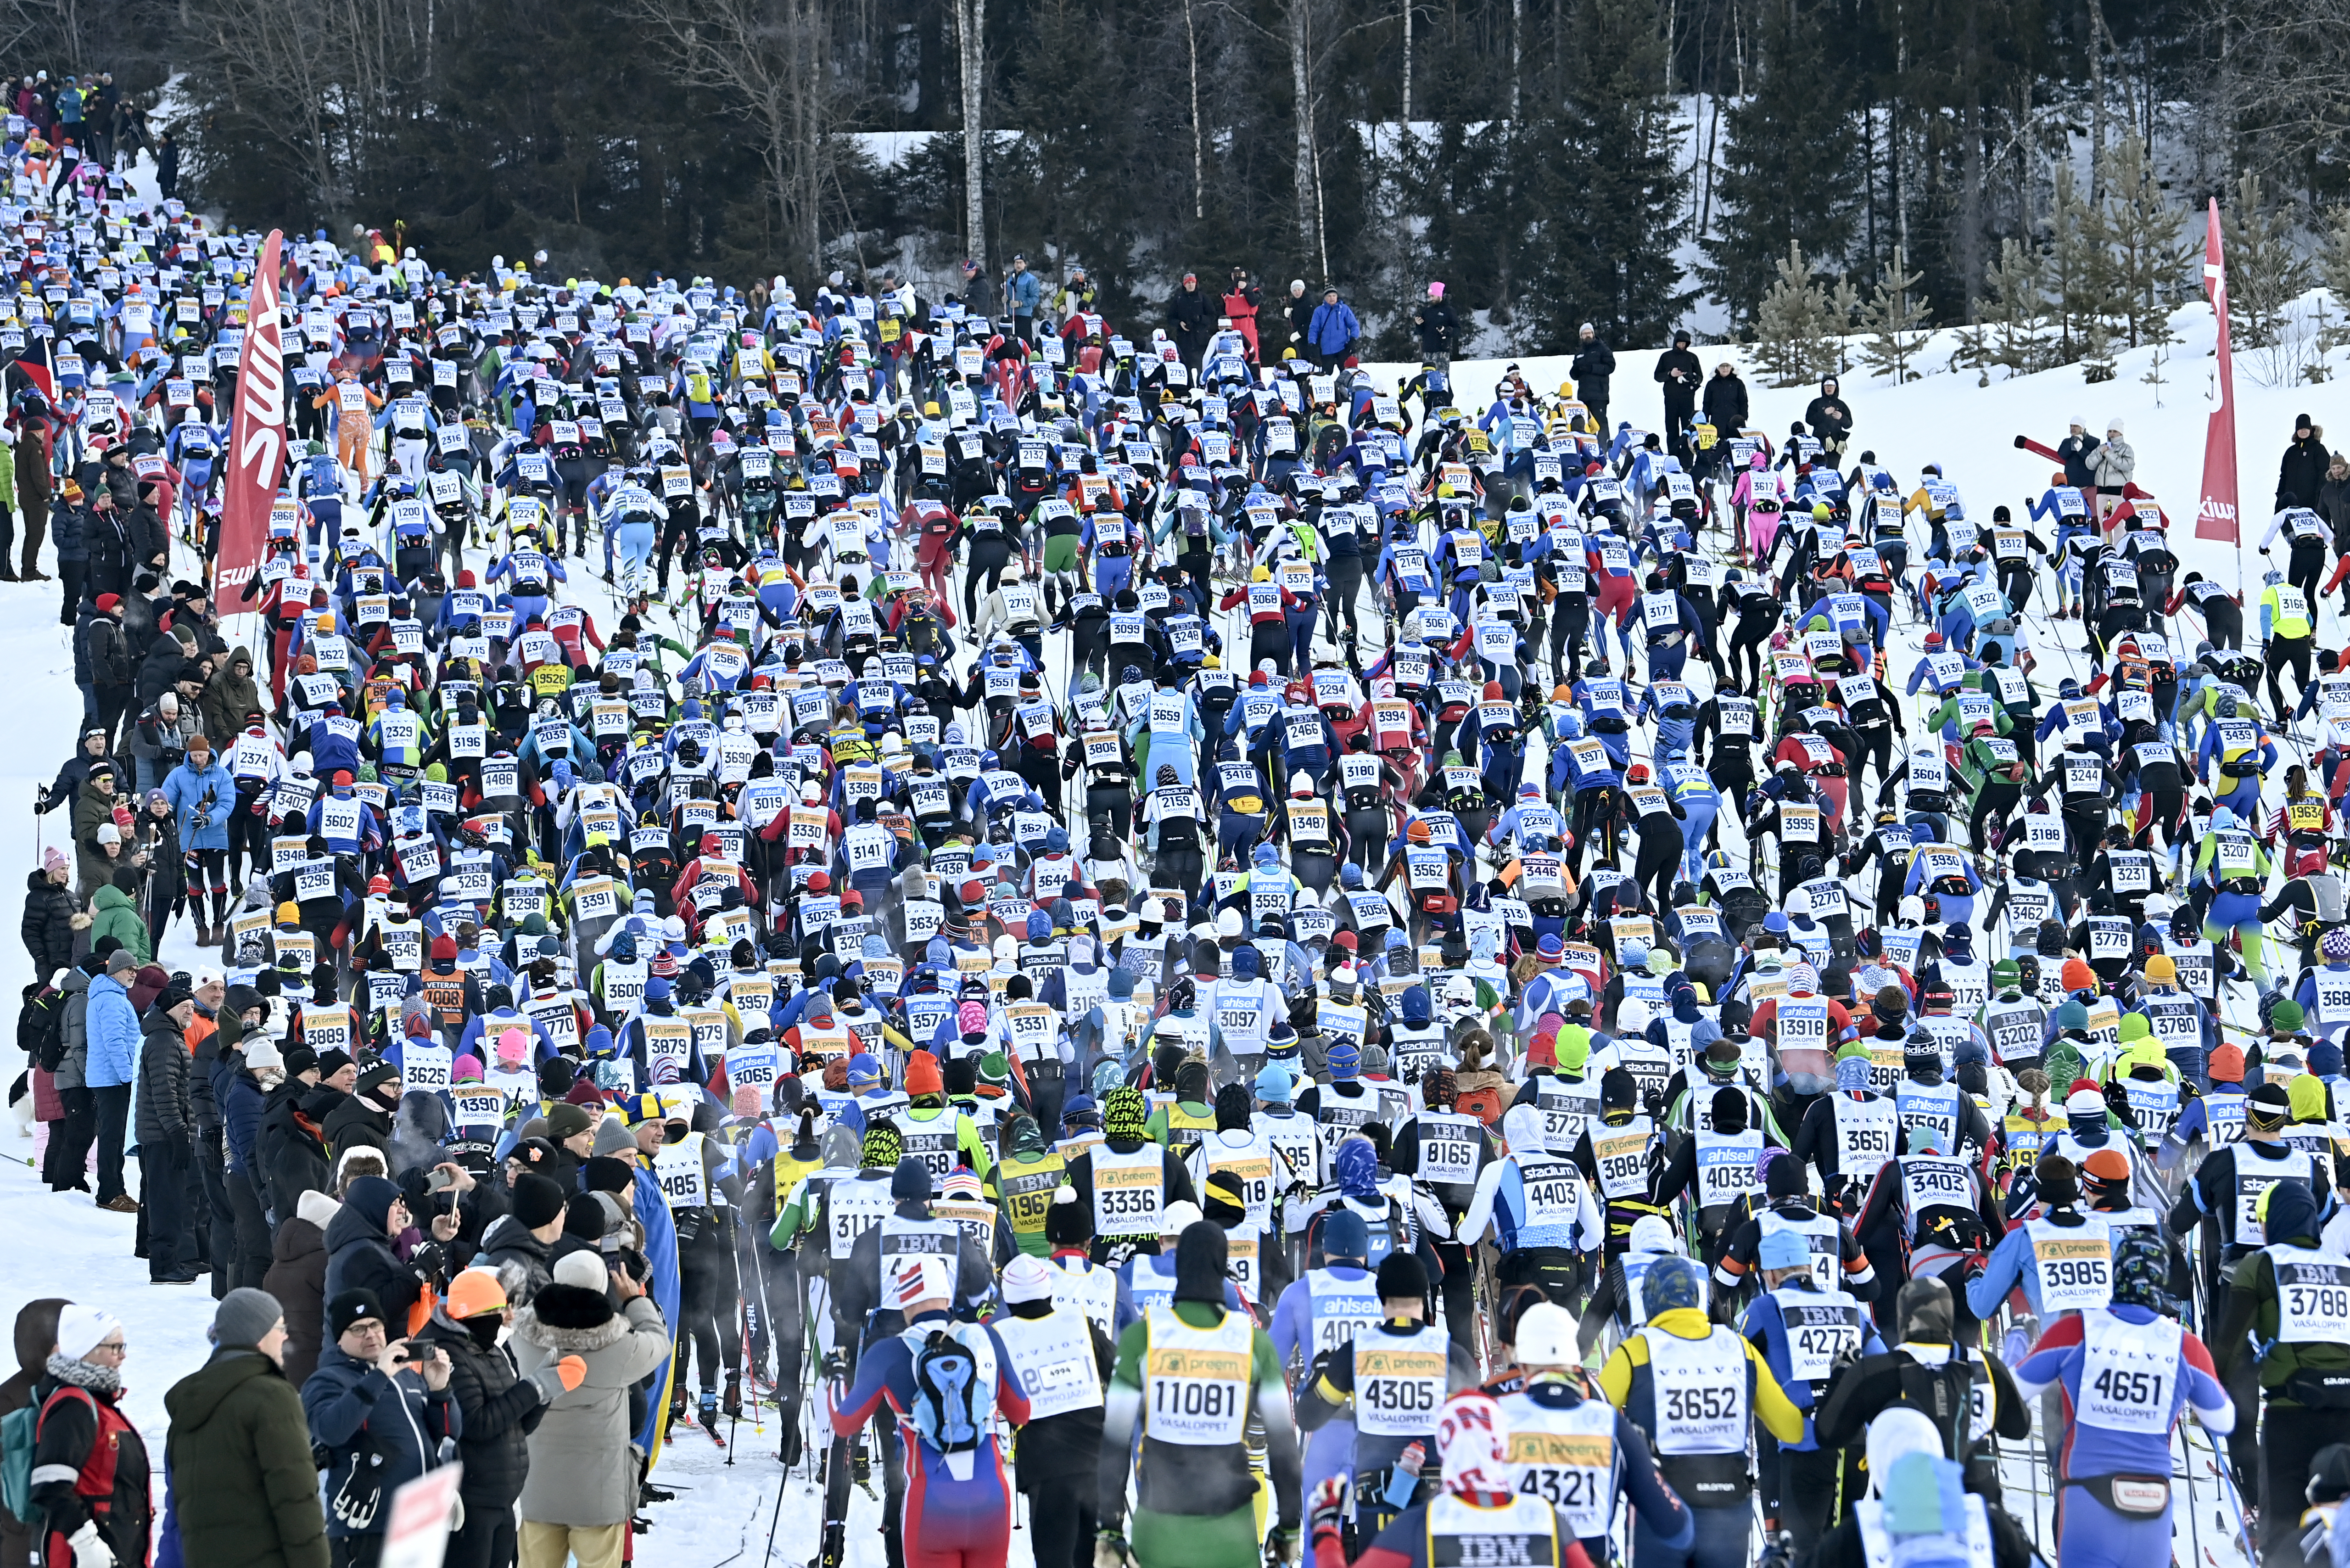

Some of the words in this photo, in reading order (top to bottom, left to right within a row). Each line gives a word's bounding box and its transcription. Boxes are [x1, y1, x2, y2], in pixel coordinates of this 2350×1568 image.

[629, 330, 647, 338] 3536
[436, 484, 457, 494] 3612
[667, 479, 688, 488] 2090
[1755, 483, 1774, 492] 3617
[2000, 539, 2023, 549] 3312
[1401, 558, 1422, 567] 2140
[218, 558, 256, 589] swi
[1009, 599, 1031, 609] 2713
[1253, 596, 1277, 605] 3068
[2283, 599, 2304, 610] 3166
[398, 634, 419, 644] 2111
[1810, 641, 1841, 650] 12935
[715, 654, 739, 666] 2586
[536, 674, 565, 686] 19526
[990, 678, 1015, 689] 3551
[309, 683, 334, 696] 3178
[747, 703, 775, 714] 3783
[597, 715, 625, 726] 3376
[1153, 710, 1181, 722] 3659
[1725, 714, 1750, 726] 2442
[1292, 724, 1318, 736] 2466
[454, 737, 481, 749] 3196
[1089, 743, 1117, 756] 3806
[241, 753, 268, 767] 2374
[949, 756, 977, 767] 2498
[486, 774, 514, 787] 4488
[1913, 770, 1942, 782] 3604
[282, 785, 312, 797] stadium
[279, 796, 308, 811] 3402
[755, 797, 783, 810] 3019
[1163, 795, 1190, 806] 2159
[2290, 806, 2322, 821] 19634
[1292, 818, 1326, 830] 13487
[1523, 817, 1552, 828] 2230
[1786, 818, 1815, 831] 3995
[793, 824, 822, 840] 3330
[854, 846, 881, 859] 3141
[2223, 846, 2250, 859] 3207
[408, 854, 436, 871] 2431
[1414, 866, 1443, 877] 3562
[1527, 868, 1557, 878] 3446
[2118, 868, 2147, 882] 3231
[300, 874, 331, 890] 3296
[582, 893, 612, 910] 3391
[1256, 895, 1286, 908] 3592
[1302, 919, 1331, 931] 3261
[2098, 923, 2124, 933] IBM
[391, 933, 413, 943] IBM
[2096, 933, 2127, 947] 3778
[1026, 956, 1062, 965] stadium
[1565, 951, 1596, 963] 3969
[868, 971, 900, 984] 3947
[427, 990, 459, 1007] 1008
[610, 985, 643, 999] 3600
[737, 996, 770, 1010] 3957
[914, 1003, 946, 1013] ahlsell
[1222, 999, 1257, 1009] ahlsell
[1785, 1008, 1823, 1018] ahlsell
[2161, 1006, 2188, 1017] IBM
[322, 1016, 348, 1025] preem
[913, 1014, 947, 1030] 3574
[1014, 1018, 1048, 1033] 3331
[1221, 1013, 1256, 1027] 3097
[1325, 1017, 1360, 1031] ahlsell
[2001, 1013, 2031, 1026] IBM
[1780, 1022, 1824, 1036] 13918
[2159, 1019, 2195, 1034] 3780
[309, 1030, 344, 1045] 3889
[2000, 1027, 2038, 1046] 3202
[652, 1040, 687, 1054] 3879
[1399, 1042, 1440, 1053] stadium
[735, 1057, 771, 1070] ahlsell
[1625, 1064, 1666, 1074] stadium
[408, 1069, 447, 1085] 3625
[734, 1070, 772, 1086] 3065
[460, 1098, 499, 1113] 4390
[1552, 1097, 1586, 1113] IBM
[1907, 1100, 1951, 1114] ahlsell
[1333, 1110, 1367, 1126] IBM
[1546, 1116, 1588, 1135] 3721
[1433, 1126, 1467, 1140] IBM
[906, 1136, 943, 1151] IBM
[1849, 1132, 1889, 1152] 3651
[1429, 1145, 1470, 1165] 8165
[1708, 1149, 1755, 1163] ahlsell
[1524, 1167, 1574, 1180] stadium
[1603, 1157, 1650, 1180] 3884
[1908, 1163, 1964, 1176] stadium
[1122, 1173, 1156, 1182] preem
[1708, 1168, 1757, 1188] 4033
[1914, 1174, 1964, 1193] 3403
[1532, 1184, 1575, 1204] 4403
[1102, 1191, 1155, 1215] 3336
[956, 1210, 989, 1219] preem
[1106, 1216, 1153, 1226] VASALOPPET
[898, 1236, 941, 1253] IBM
[2066, 1244, 2105, 1254] preem
[2045, 1262, 2107, 1287] 3985
[2294, 1266, 2340, 1285] IBM
[2051, 1290, 2107, 1299] VASALOPPET
[1325, 1298, 1383, 1315] ahlsell
[2290, 1289, 2348, 1317] 3788
[1801, 1308, 1846, 1325] IBM
[2293, 1320, 2346, 1331] VASALOPPET
[2093, 1348, 2174, 1364] VOLVO
[1191, 1359, 1239, 1372] preem
[1394, 1360, 1437, 1370] preem
[1050, 1368, 1071, 1378] 4994
[1659, 1367, 1741, 1377] VOLVO
[2095, 1370, 2162, 1406] 4651
[1156, 1382, 1235, 1417] 11081
[1366, 1382, 1433, 1411] 4305
[1667, 1389, 1736, 1421] 3652
[1369, 1414, 1430, 1425] VASALOPPET
[2092, 1405, 2157, 1421] VASALOPPET
[1160, 1419, 1228, 1433] VASALOPPET
[1671, 1424, 1735, 1436] VASALOPPET
[1550, 1443, 1602, 1457] preem
[1521, 1471, 1595, 1507] 4321
[1697, 1484, 1735, 1492] salomon
[1460, 1537, 1531, 1567] IBM
